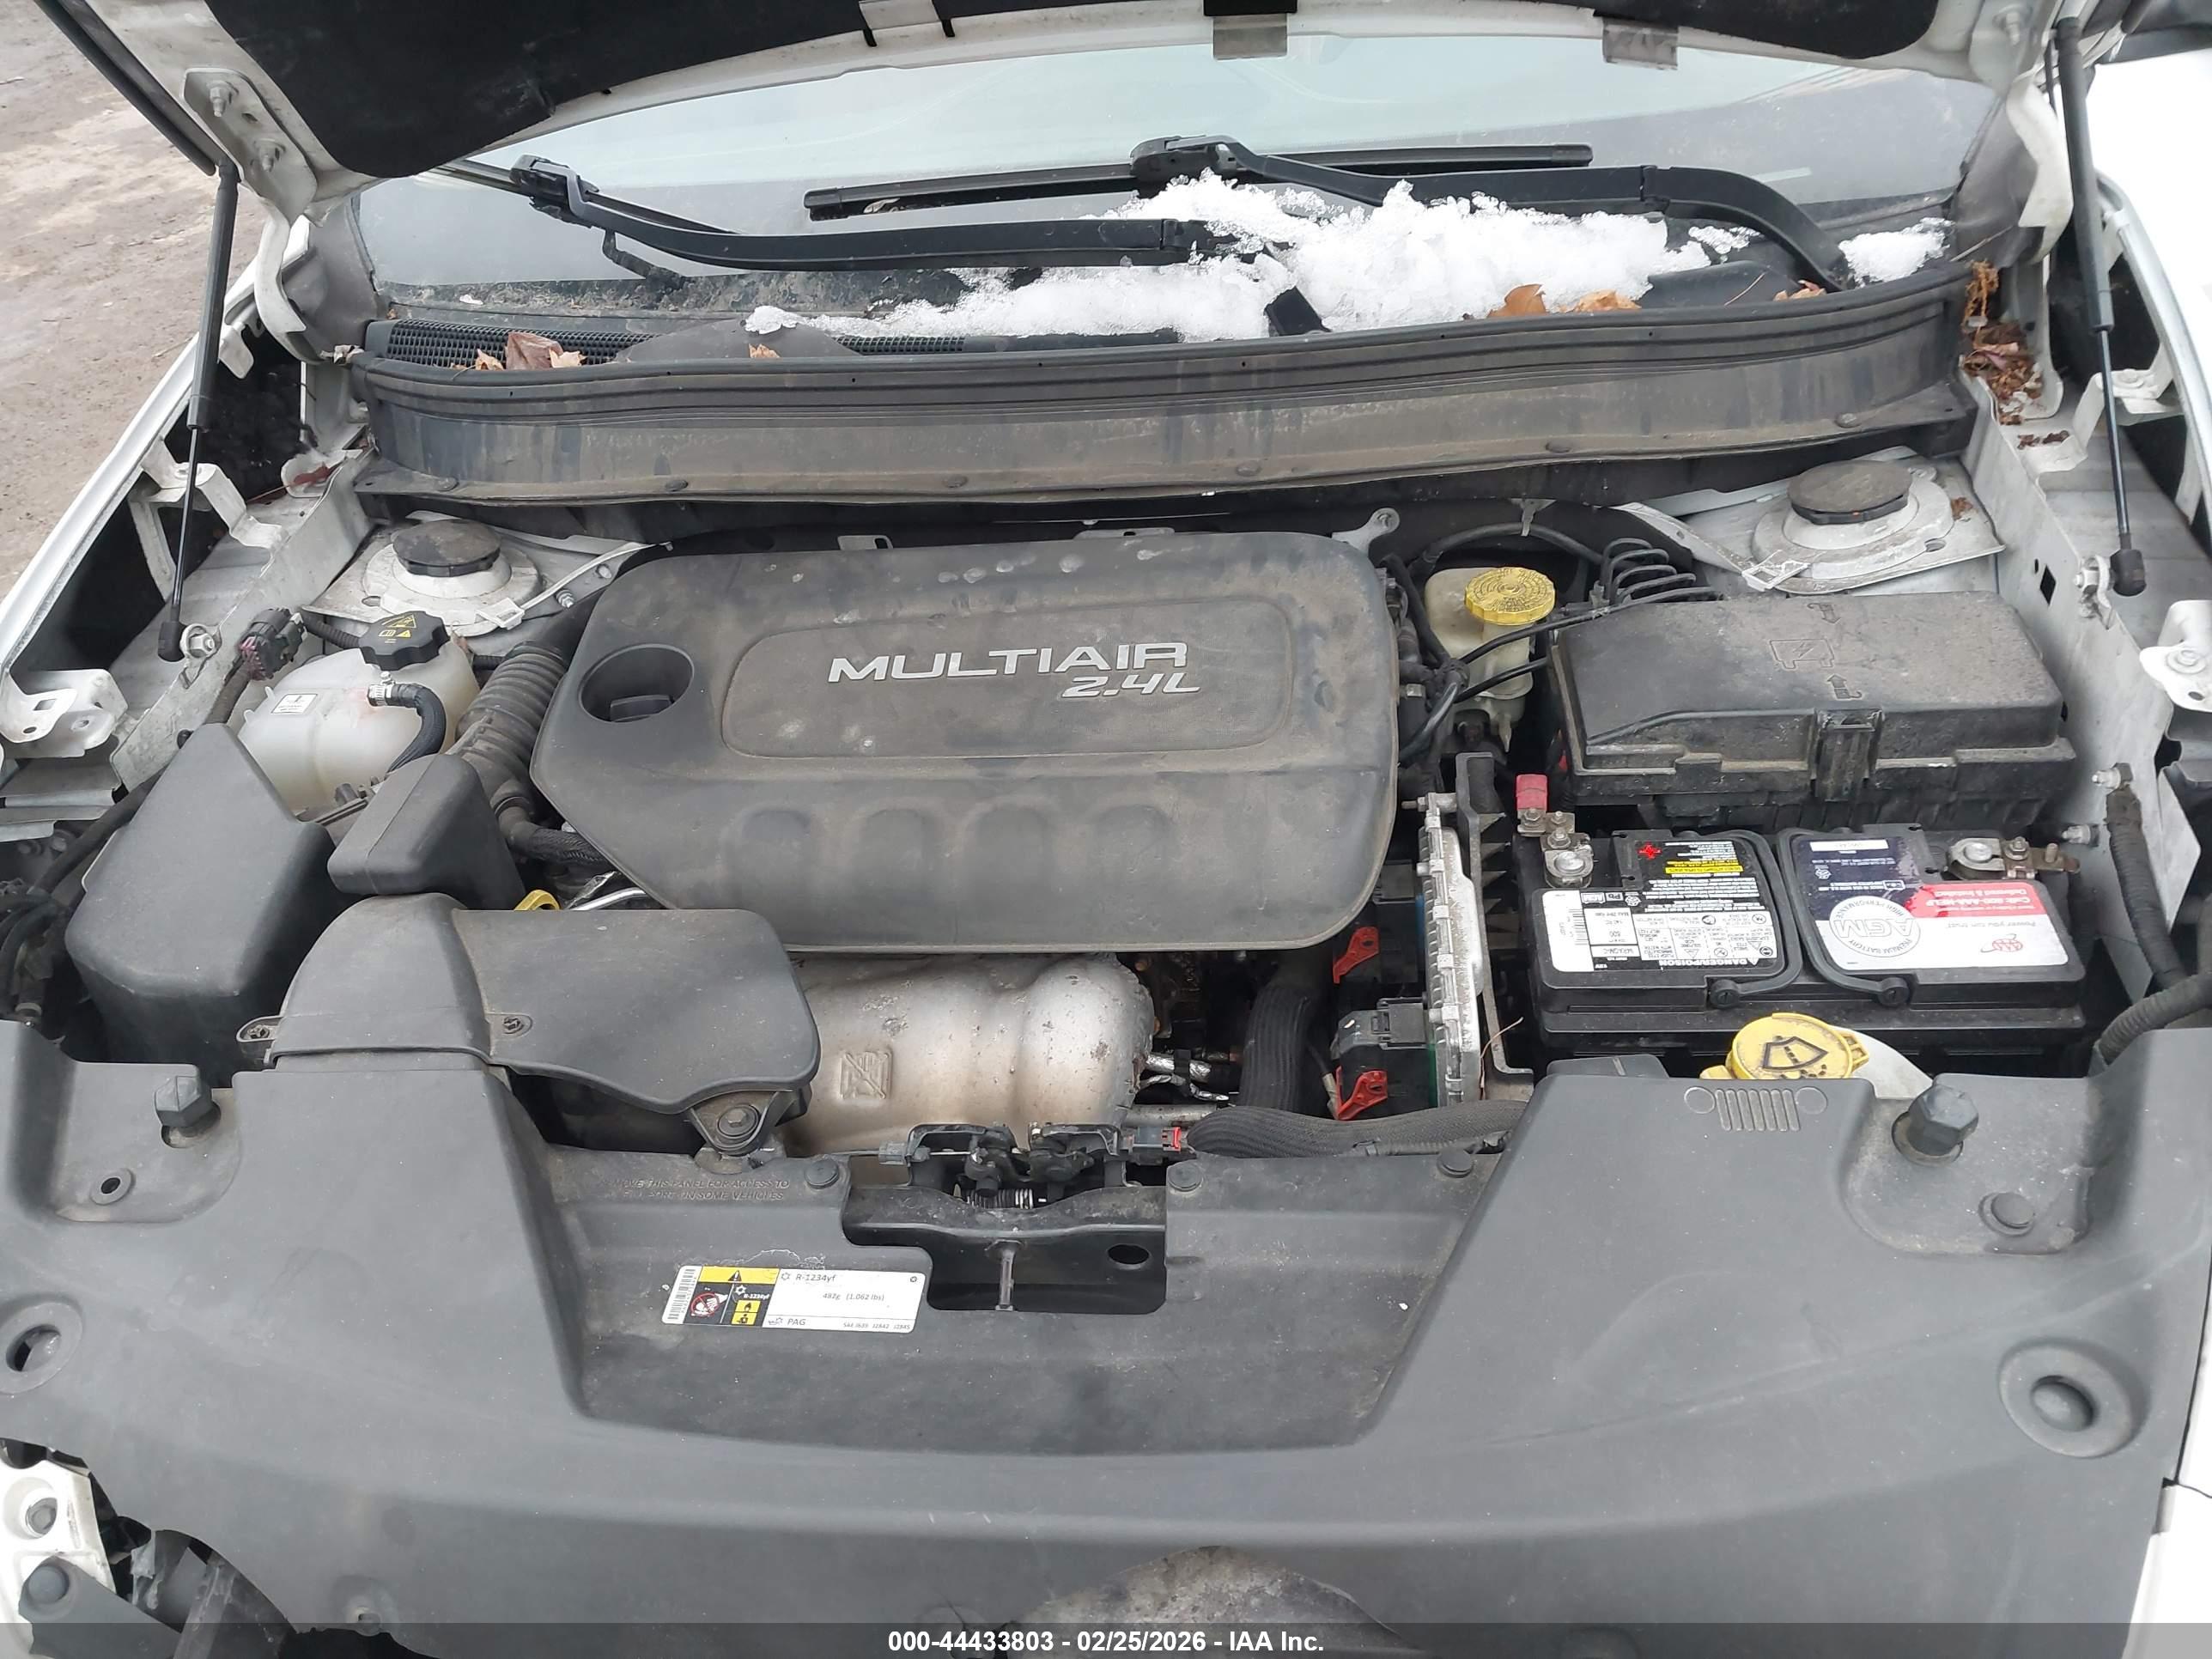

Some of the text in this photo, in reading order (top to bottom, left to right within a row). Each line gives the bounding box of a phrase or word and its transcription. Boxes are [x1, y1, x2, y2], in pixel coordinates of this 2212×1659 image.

[827, 641, 1188, 683] MULTIAIR
[1061, 672, 1201, 698] 2.4L
[1832, 918, 1915, 939] AGM
[1658, 958, 1747, 967] DANGER/POISON
[775, 1180, 790, 1189] TO
[795, 1273, 837, 1283] R-1234yf
